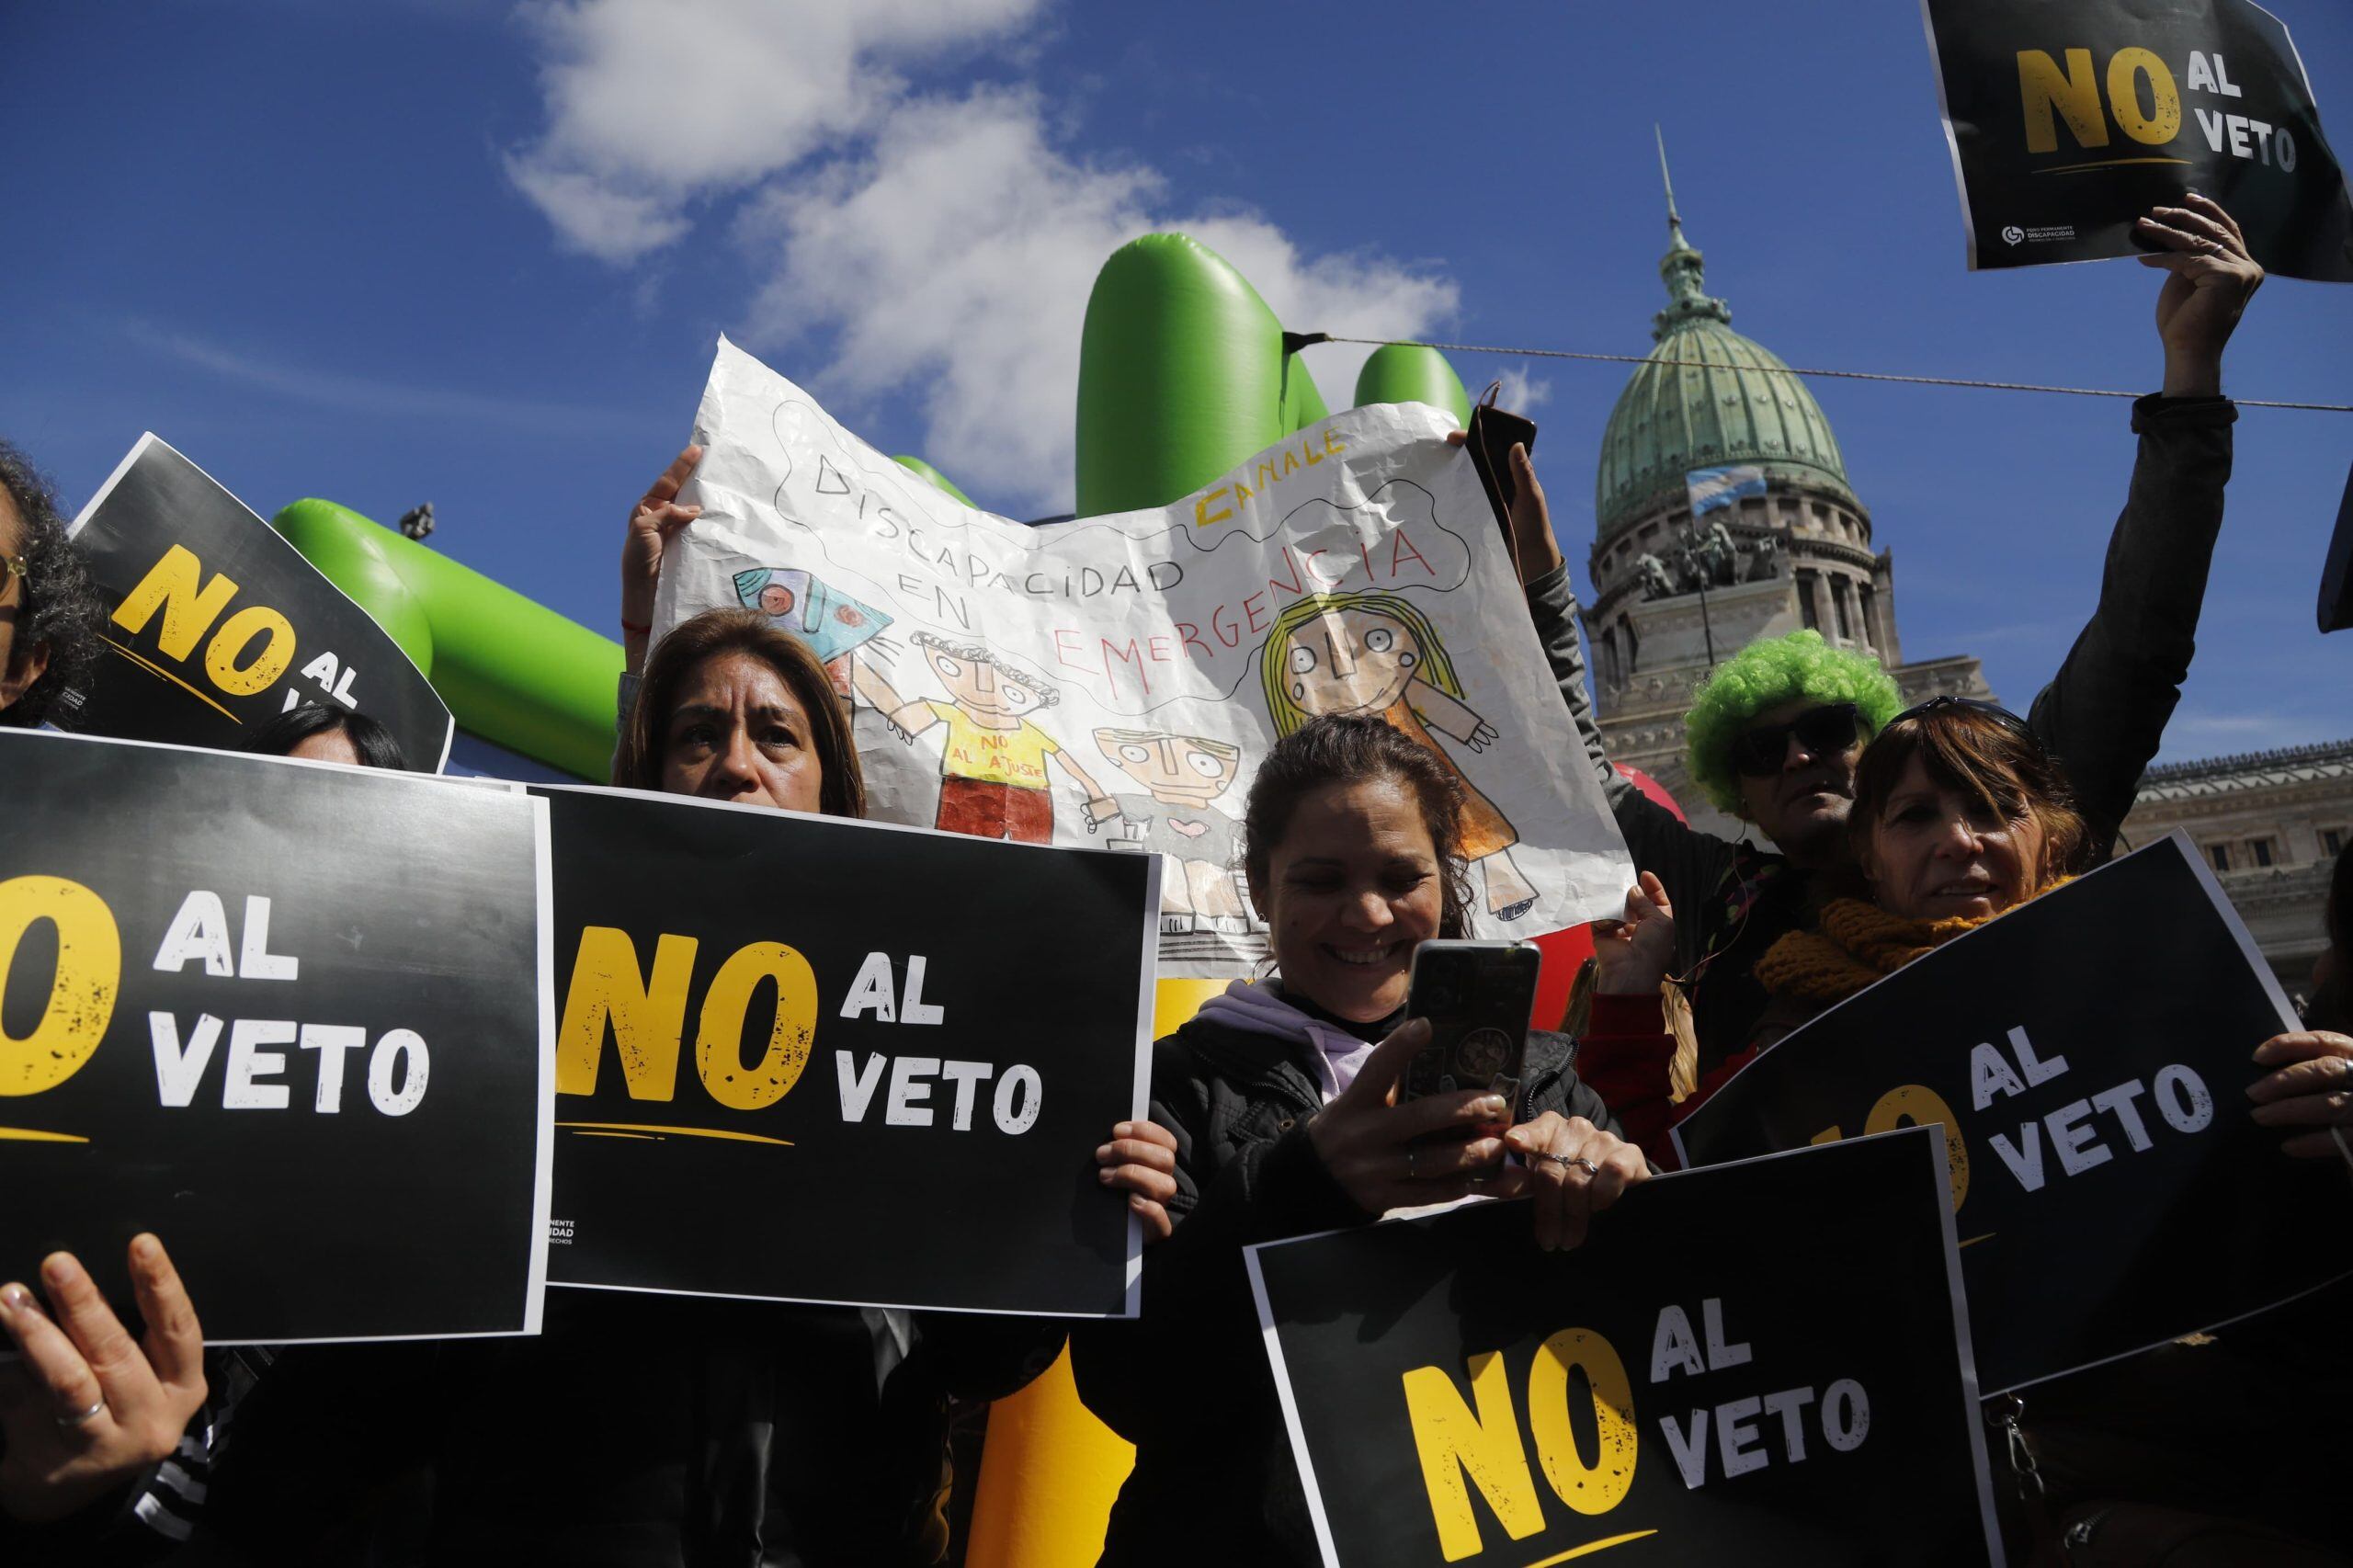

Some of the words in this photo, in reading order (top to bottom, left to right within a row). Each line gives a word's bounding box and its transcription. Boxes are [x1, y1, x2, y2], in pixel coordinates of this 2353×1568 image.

[2017, 46, 2182, 153] NO
[2188, 51, 2242, 98] AL
[2194, 108, 2296, 173] VETO
[2027, 230, 2075, 238] DISCAPACIDAD
[111, 543, 296, 696] NO
[898, 574, 971, 630] EN
[301, 651, 358, 710] AL
[952, 748, 972, 764] AL
[989, 756, 1042, 778] AJUSTE
[981, 735, 1008, 750] NO
[153, 890, 299, 981] AL
[0, 875, 121, 1096] O
[555, 926, 819, 1110] NO
[840, 952, 945, 1025] AL
[149, 1011, 430, 1117] VETO
[835, 1050, 1042, 1135] VETO
[1971, 1025, 2070, 1111] AL
[1988, 1064, 2214, 1193] VETO
[550, 1220, 574, 1228] NENTE
[1650, 1297, 1752, 1383] AL
[1402, 1326, 1639, 1563] NO
[1659, 1379, 1870, 1490] VETO
